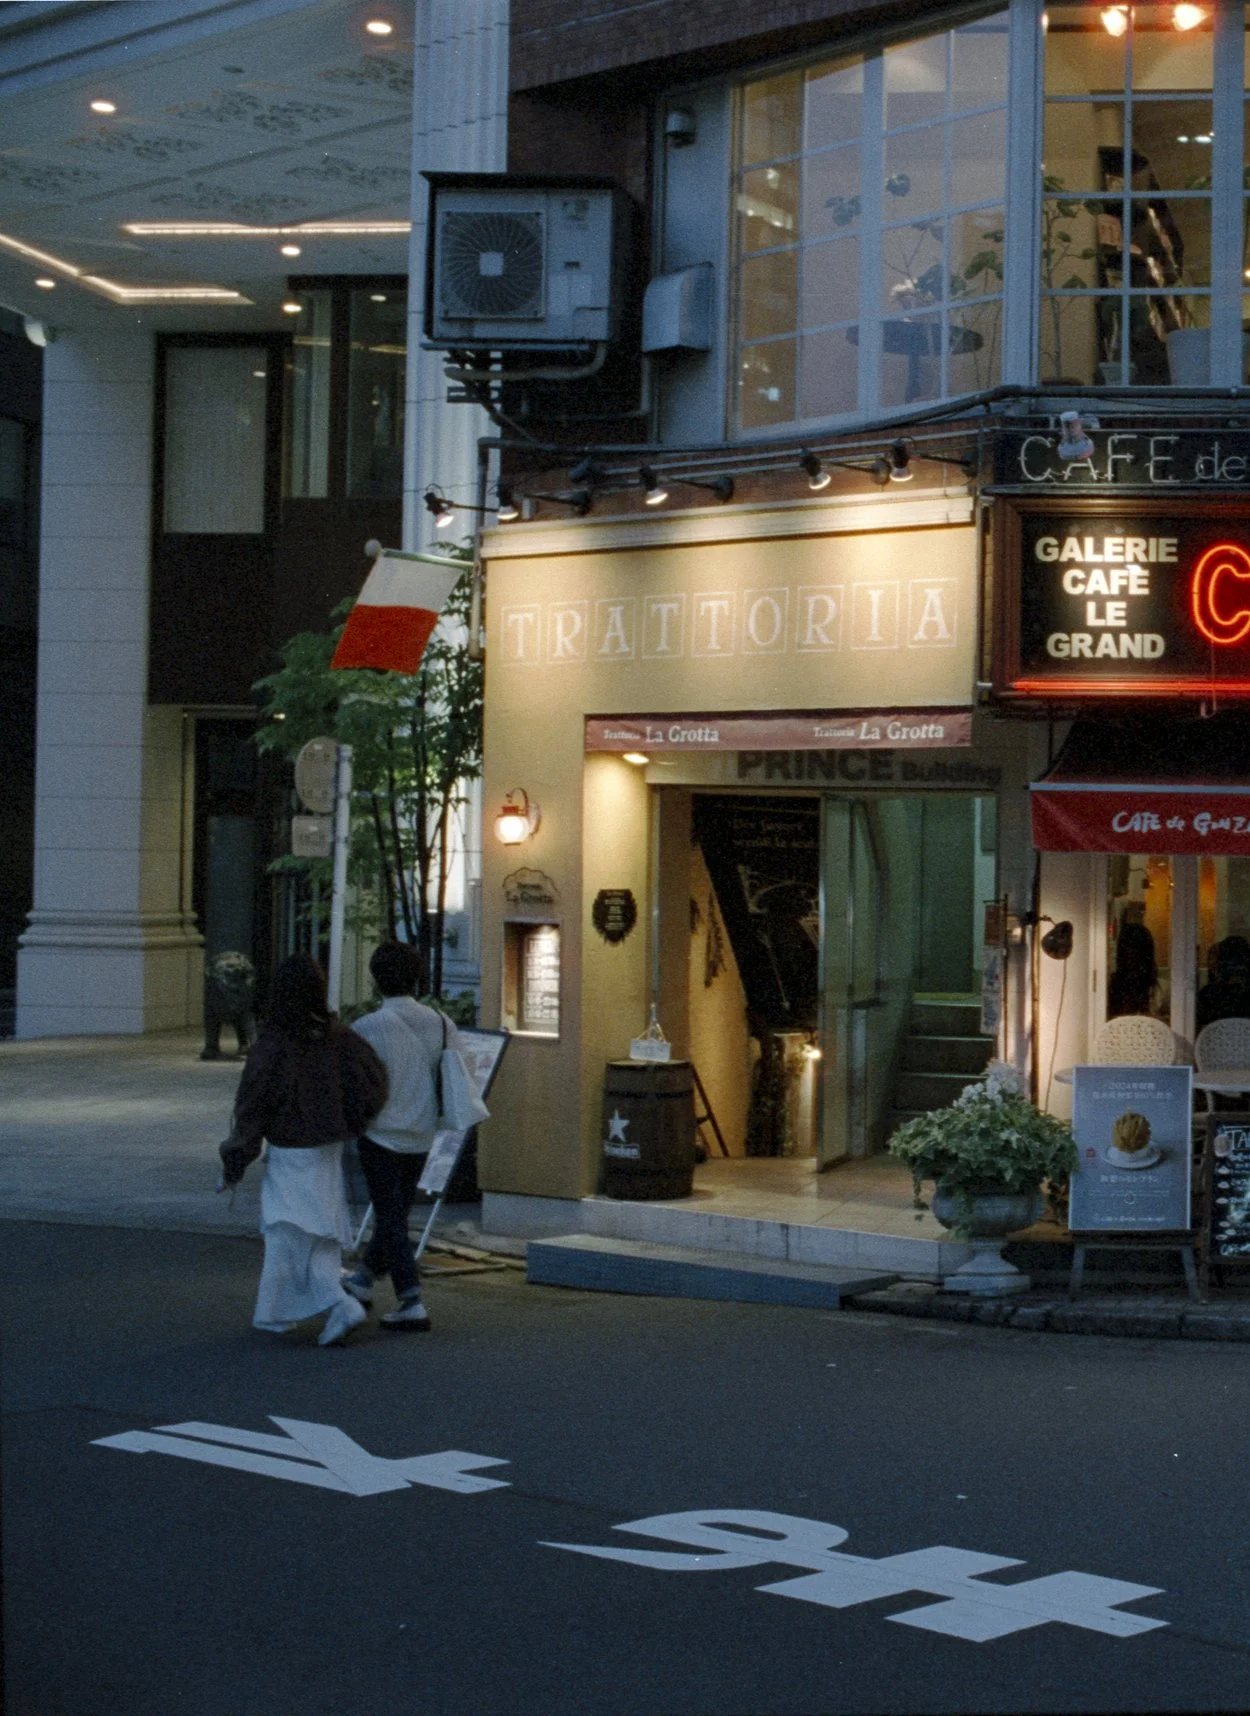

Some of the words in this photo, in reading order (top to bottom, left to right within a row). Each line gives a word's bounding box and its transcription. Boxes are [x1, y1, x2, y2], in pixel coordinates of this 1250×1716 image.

[1019, 434, 1180, 484] CAFE
[1195, 441, 1247, 481] de
[1034, 536, 1179, 563] GALERIE
[507, 586, 953, 659] TRATTORIA
[1086, 601, 1128, 627] LE
[1046, 632, 1165, 659] GRAND
[645, 726, 664, 743] La
[668, 725, 720, 743] Grotta
[859, 722, 881, 740] La
[886, 721, 945, 740] Grotta
[736, 748, 896, 781] PRINCE
